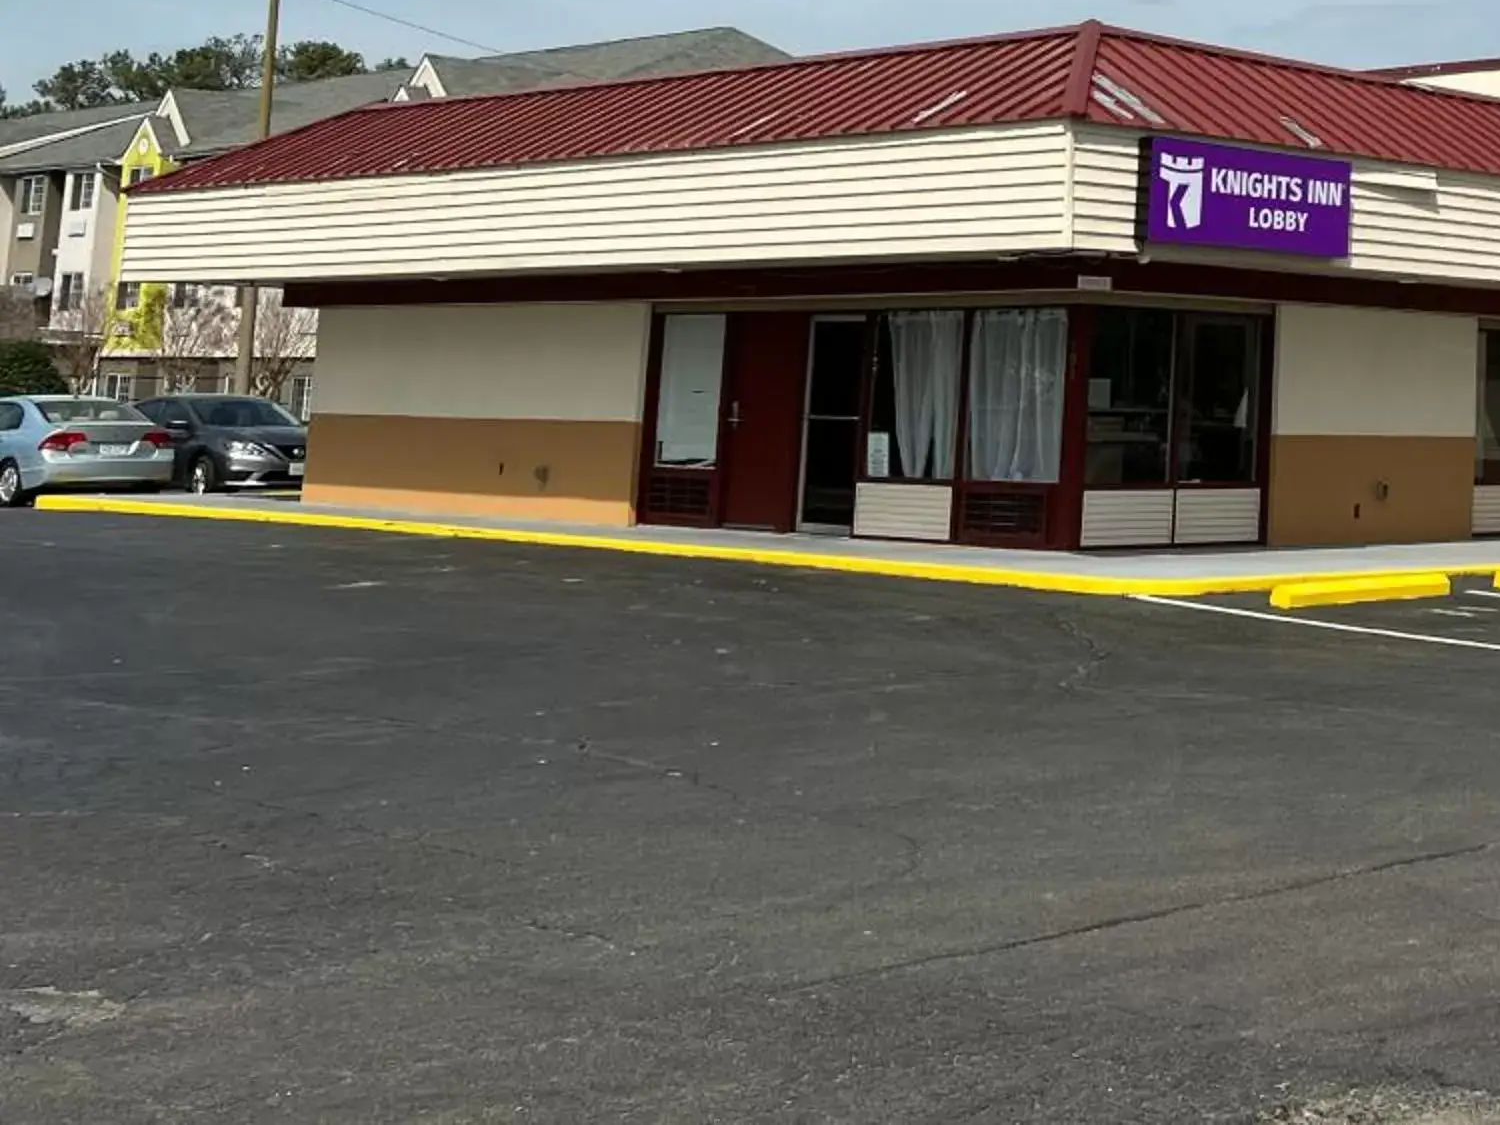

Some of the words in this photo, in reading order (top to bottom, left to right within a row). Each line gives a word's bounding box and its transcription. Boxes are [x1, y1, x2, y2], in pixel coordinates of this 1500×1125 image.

[1211, 167, 1303, 202] KNIGHTS
[1307, 178, 1343, 207] INN
[1249, 207, 1309, 232] LOBBY
